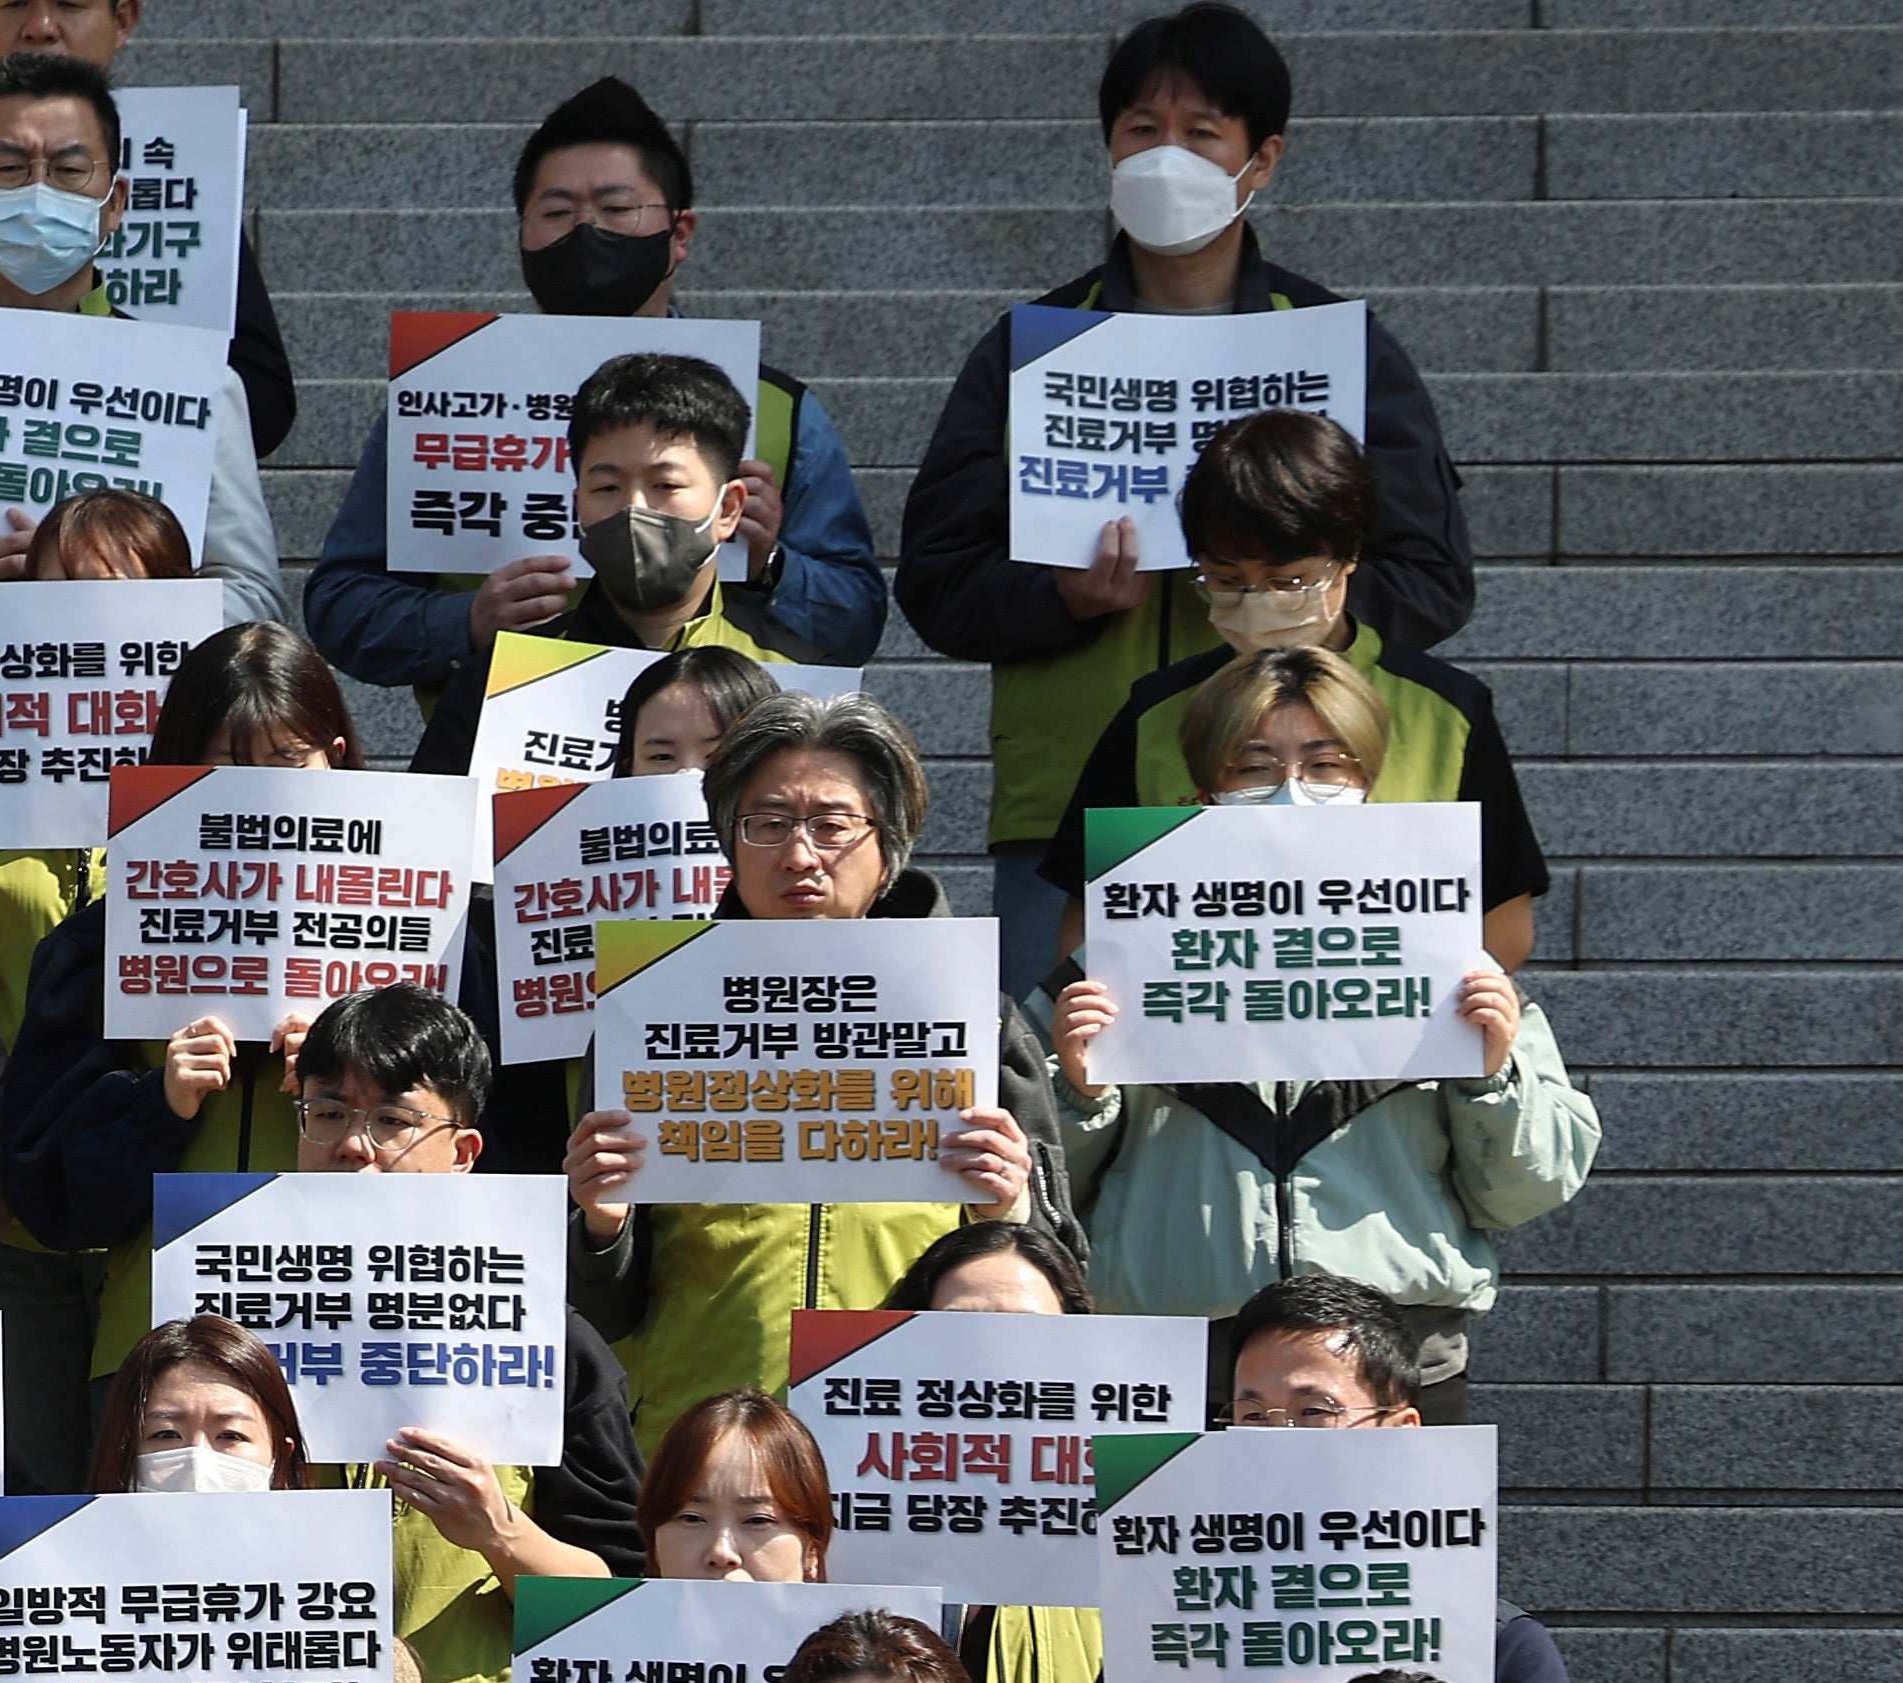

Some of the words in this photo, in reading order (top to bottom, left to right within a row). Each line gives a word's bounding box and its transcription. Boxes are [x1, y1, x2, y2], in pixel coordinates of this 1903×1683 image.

[69, 382, 212, 431] 우선이다
[1045, 371, 1178, 412] 국민생명
[1190, 370, 1330, 413] 위협하는
[22, 419, 142, 469] 곁으로
[1045, 412, 1178, 454] 진료거부
[1019, 455, 1171, 505] 진료거부
[198, 813, 382, 855] 불법의료에
[125, 859, 283, 902] 간호사가
[295, 863, 453, 910] 내몰린다
[1103, 882, 1180, 920] 환자
[1191, 879, 1304, 918] 생명이
[1317, 877, 1471, 916] 우선이다
[139, 908, 279, 946] 진료거부
[292, 911, 431, 953] 전공의들
[1171, 928, 1260, 971] 환자
[1273, 926, 1403, 970] 곁으로
[118, 954, 268, 996] 병원으로
[723, 975, 878, 1014] 병원장은
[1142, 980, 1231, 1024] 즉각
[1243, 976, 1431, 1022] 돌아오라!
[644, 1022, 799, 1061] 진료거부
[813, 1021, 967, 1060] 방관말고
[623, 1068, 877, 1114] 병원정상화를
[890, 1068, 974, 1112] 위해
[658, 1119, 785, 1164] 책임을
[798, 1116, 939, 1162] 다하라!
[1112, 1515, 1181, 1556] 환자
[1190, 1511, 1305, 1554] 생명이
[1318, 1507, 1487, 1551] 우선이다
[120, 1582, 285, 1624] 무급휴가
[1173, 1564, 1258, 1612] 환자
[1271, 1562, 1411, 1611] 곁으로
[226, 1630, 382, 1671] 위태롭다
[1151, 1622, 1230, 1669] 즉각
[1241, 1617, 1441, 1669] 돌아오라!
